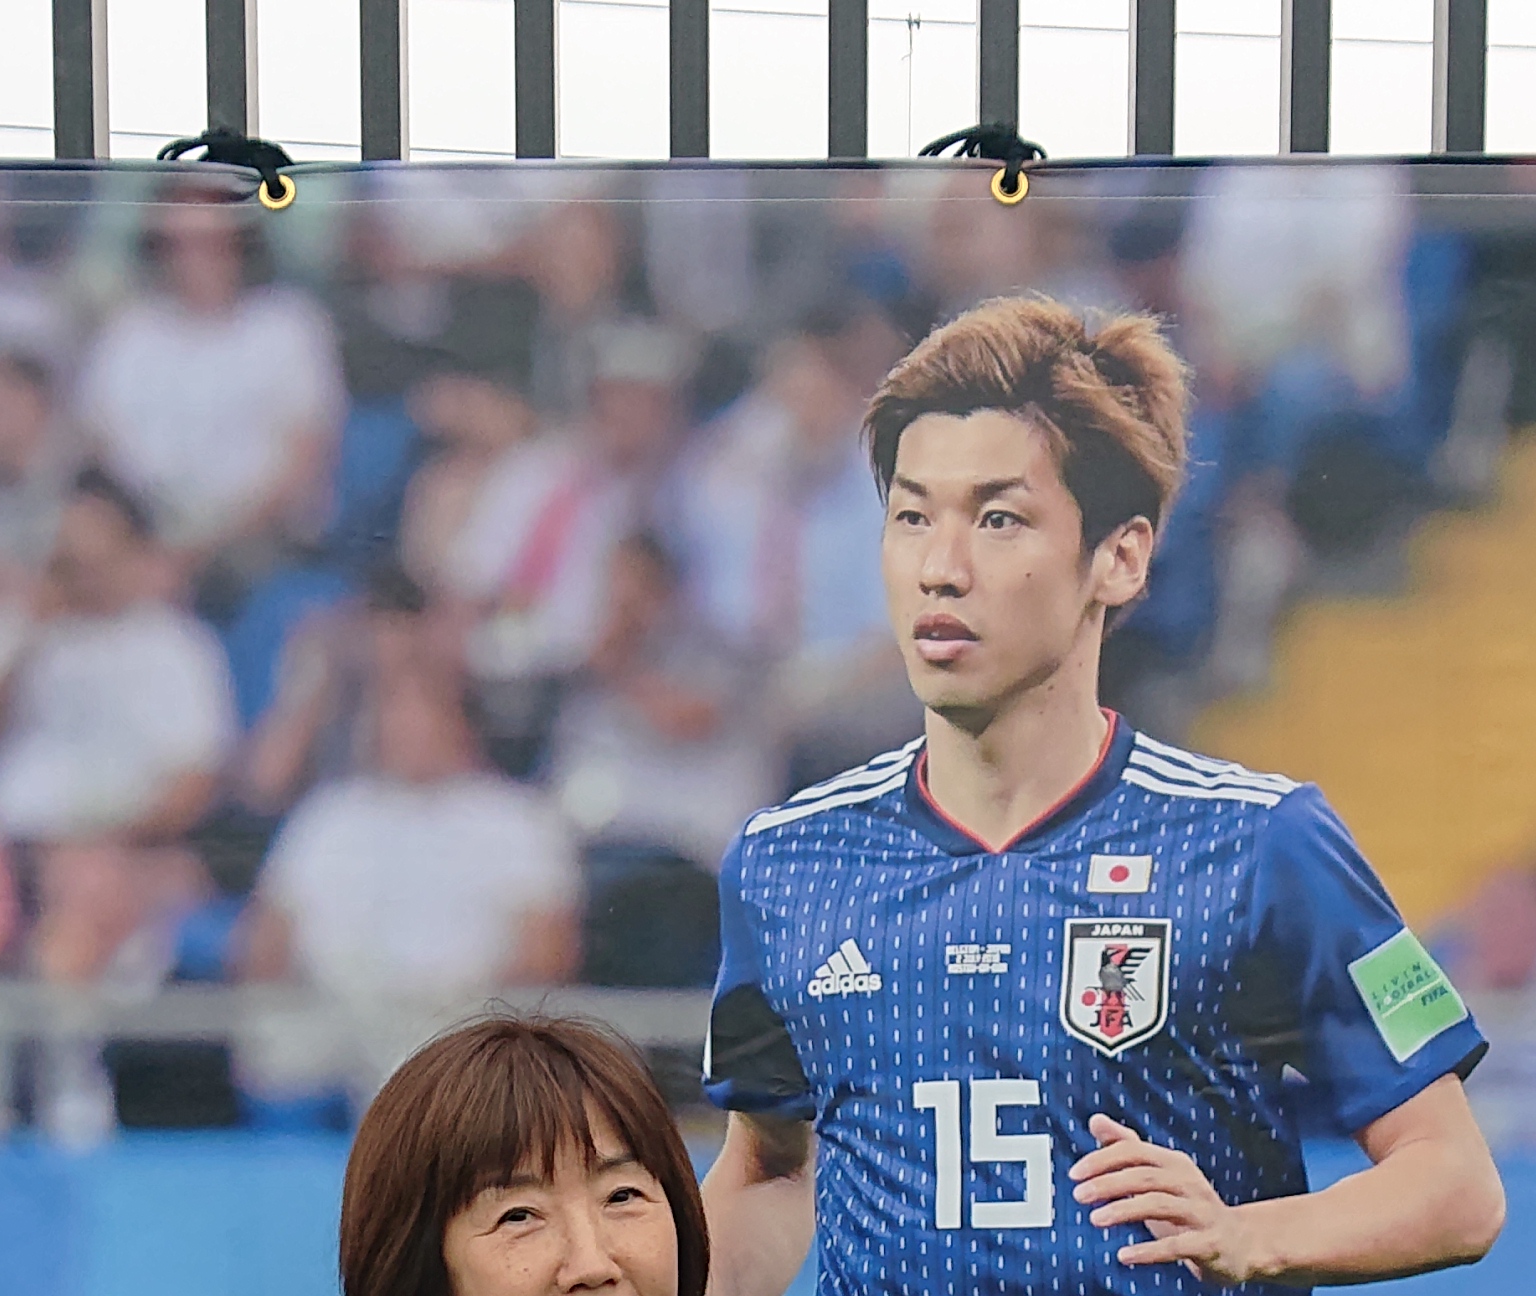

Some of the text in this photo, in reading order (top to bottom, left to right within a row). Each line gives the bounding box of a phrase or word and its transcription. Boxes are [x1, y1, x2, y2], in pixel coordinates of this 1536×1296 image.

[1091, 924, 1144, 936] JAPAN
[807, 973, 882, 997] adidas
[1421, 985, 1448, 1007] FIFA
[1090, 1010, 1133, 1028] JFA
[913, 1078, 1053, 1229] 15
